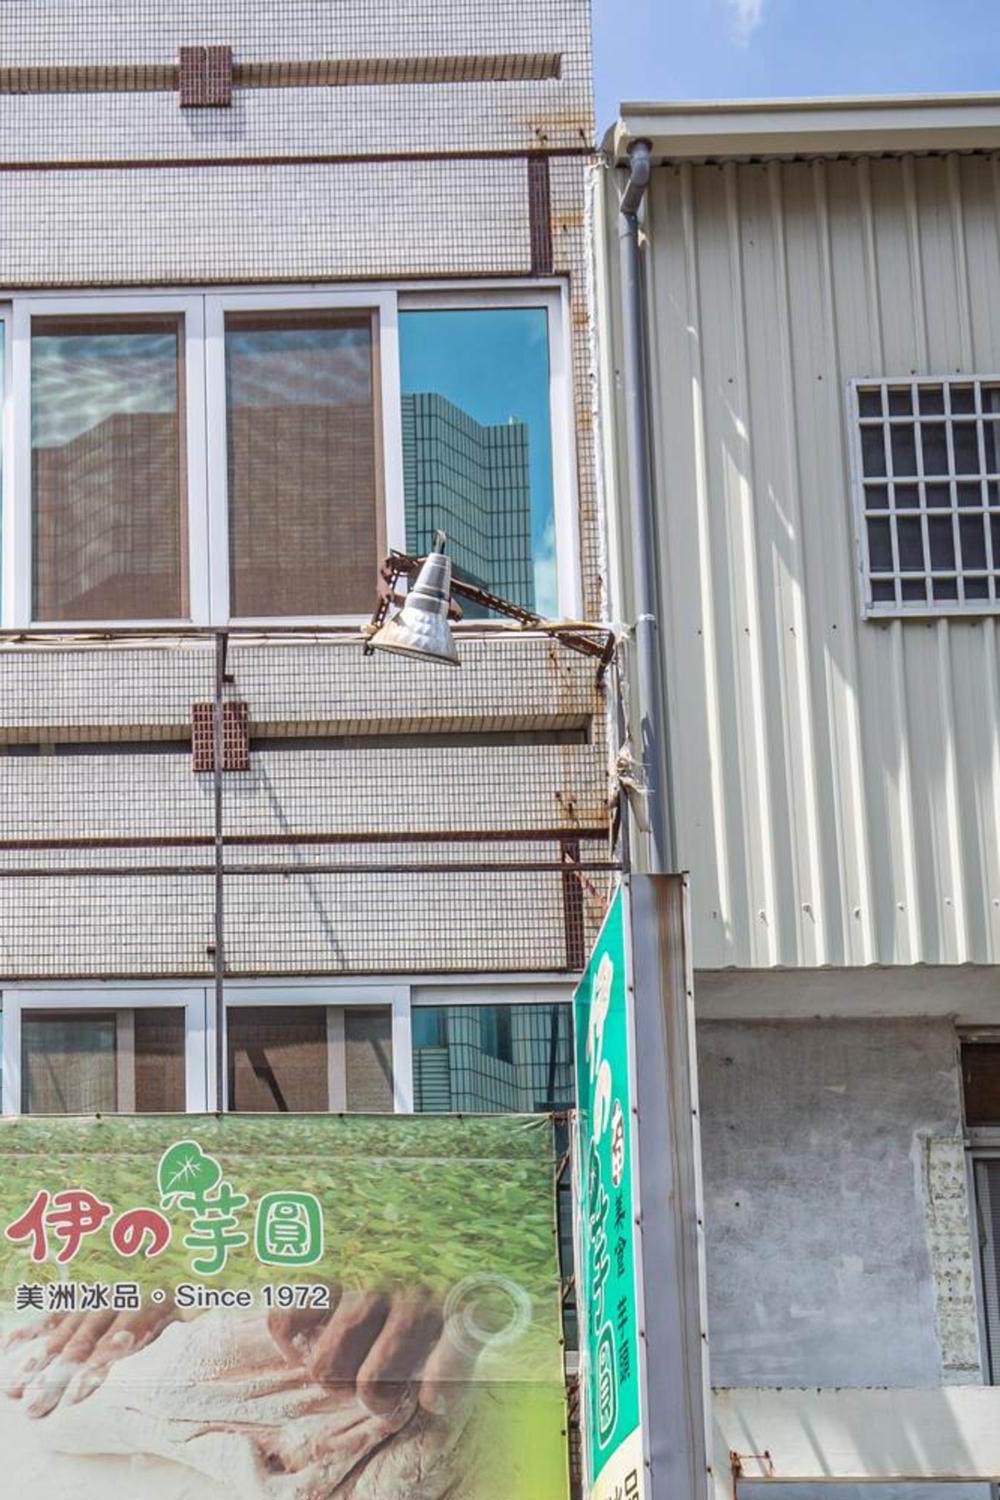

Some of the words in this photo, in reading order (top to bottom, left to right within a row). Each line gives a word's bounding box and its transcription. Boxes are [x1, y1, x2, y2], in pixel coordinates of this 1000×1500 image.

[6, 1178, 325, 1275] 伊の芋圓
[586, 951, 617, 1450] 伊の芋圓
[175, 1284, 253, 1309] Since
[262, 1284, 330, 1310] 1972
